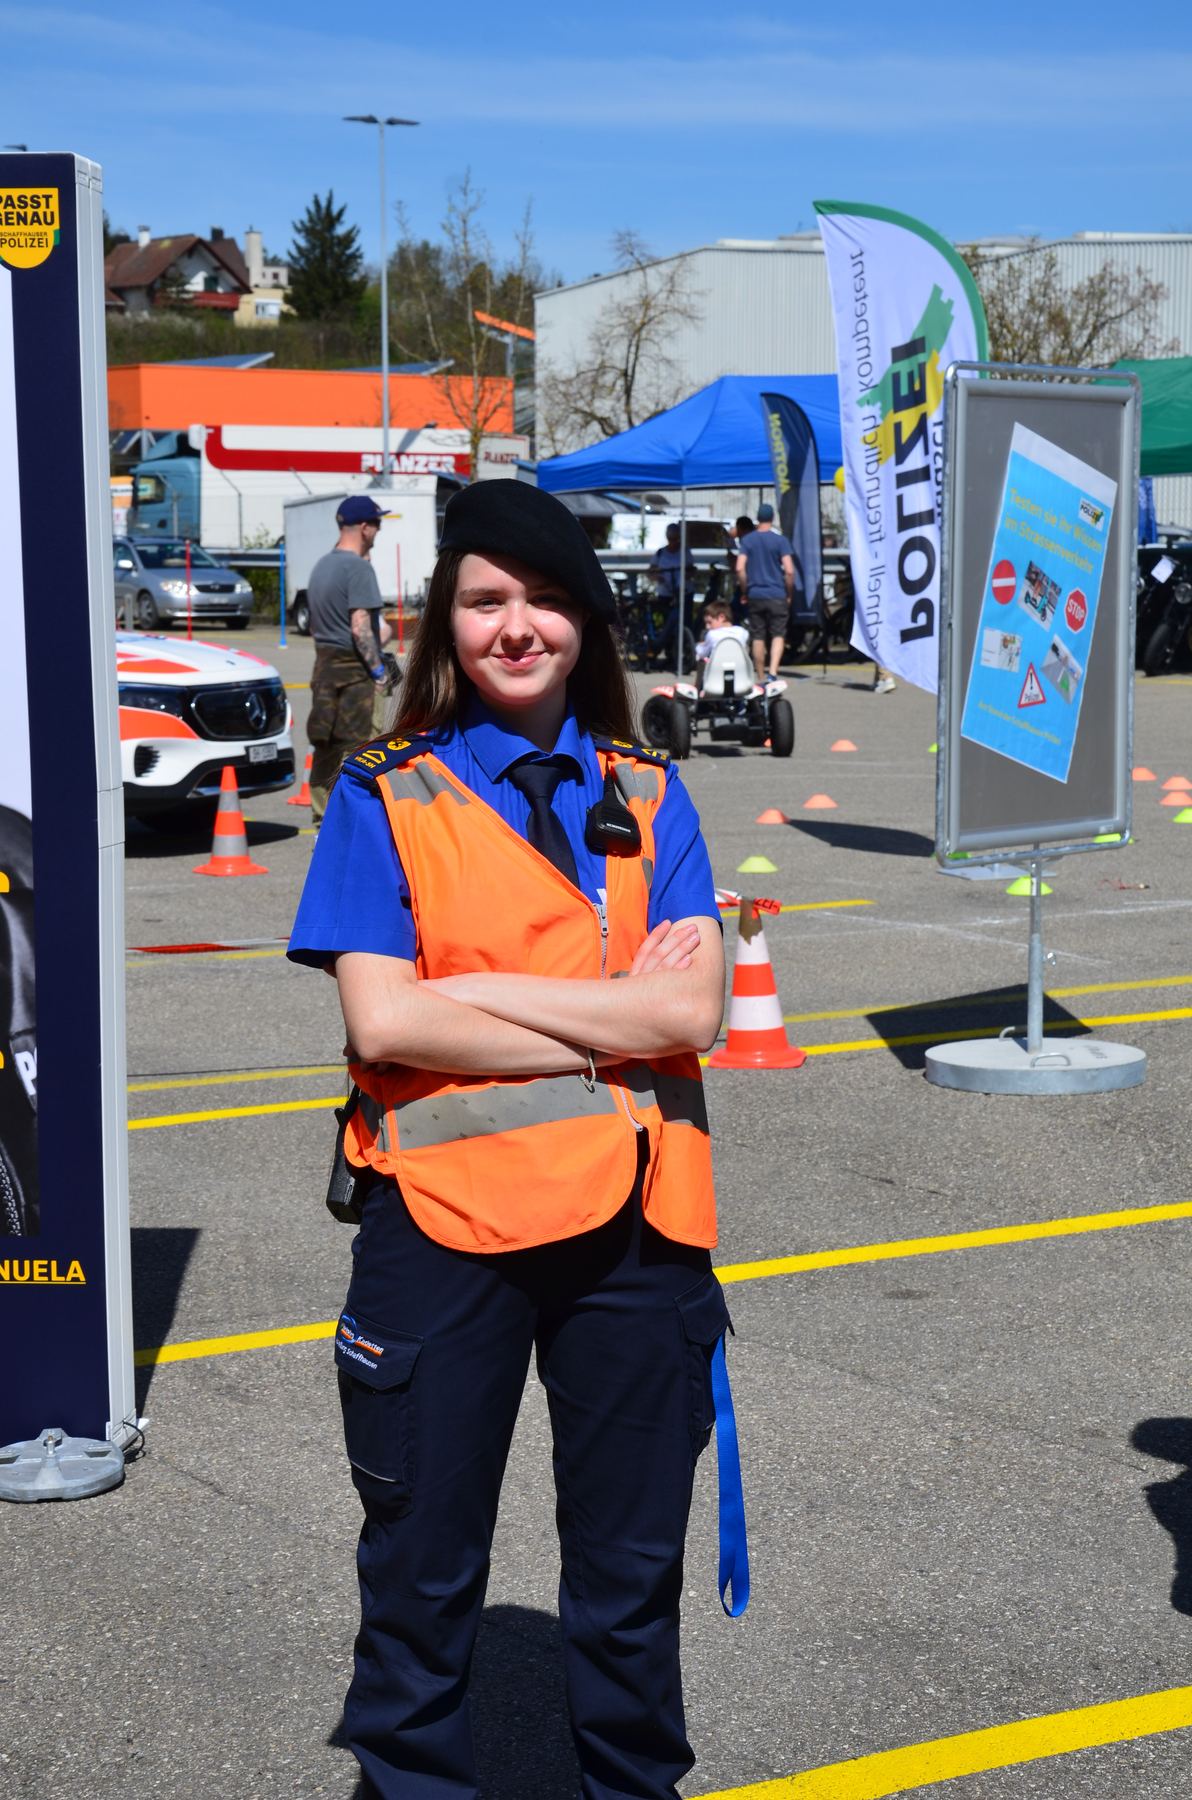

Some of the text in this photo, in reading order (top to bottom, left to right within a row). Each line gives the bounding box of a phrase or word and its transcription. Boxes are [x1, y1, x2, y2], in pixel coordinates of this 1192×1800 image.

[0, 195, 53, 209] ASST
[0, 211, 55, 226] ENAU
[0, 238, 48, 248] POLIZEI
[361, 453, 455, 473] PLANZER
[1067, 599, 1086, 622] STOP
